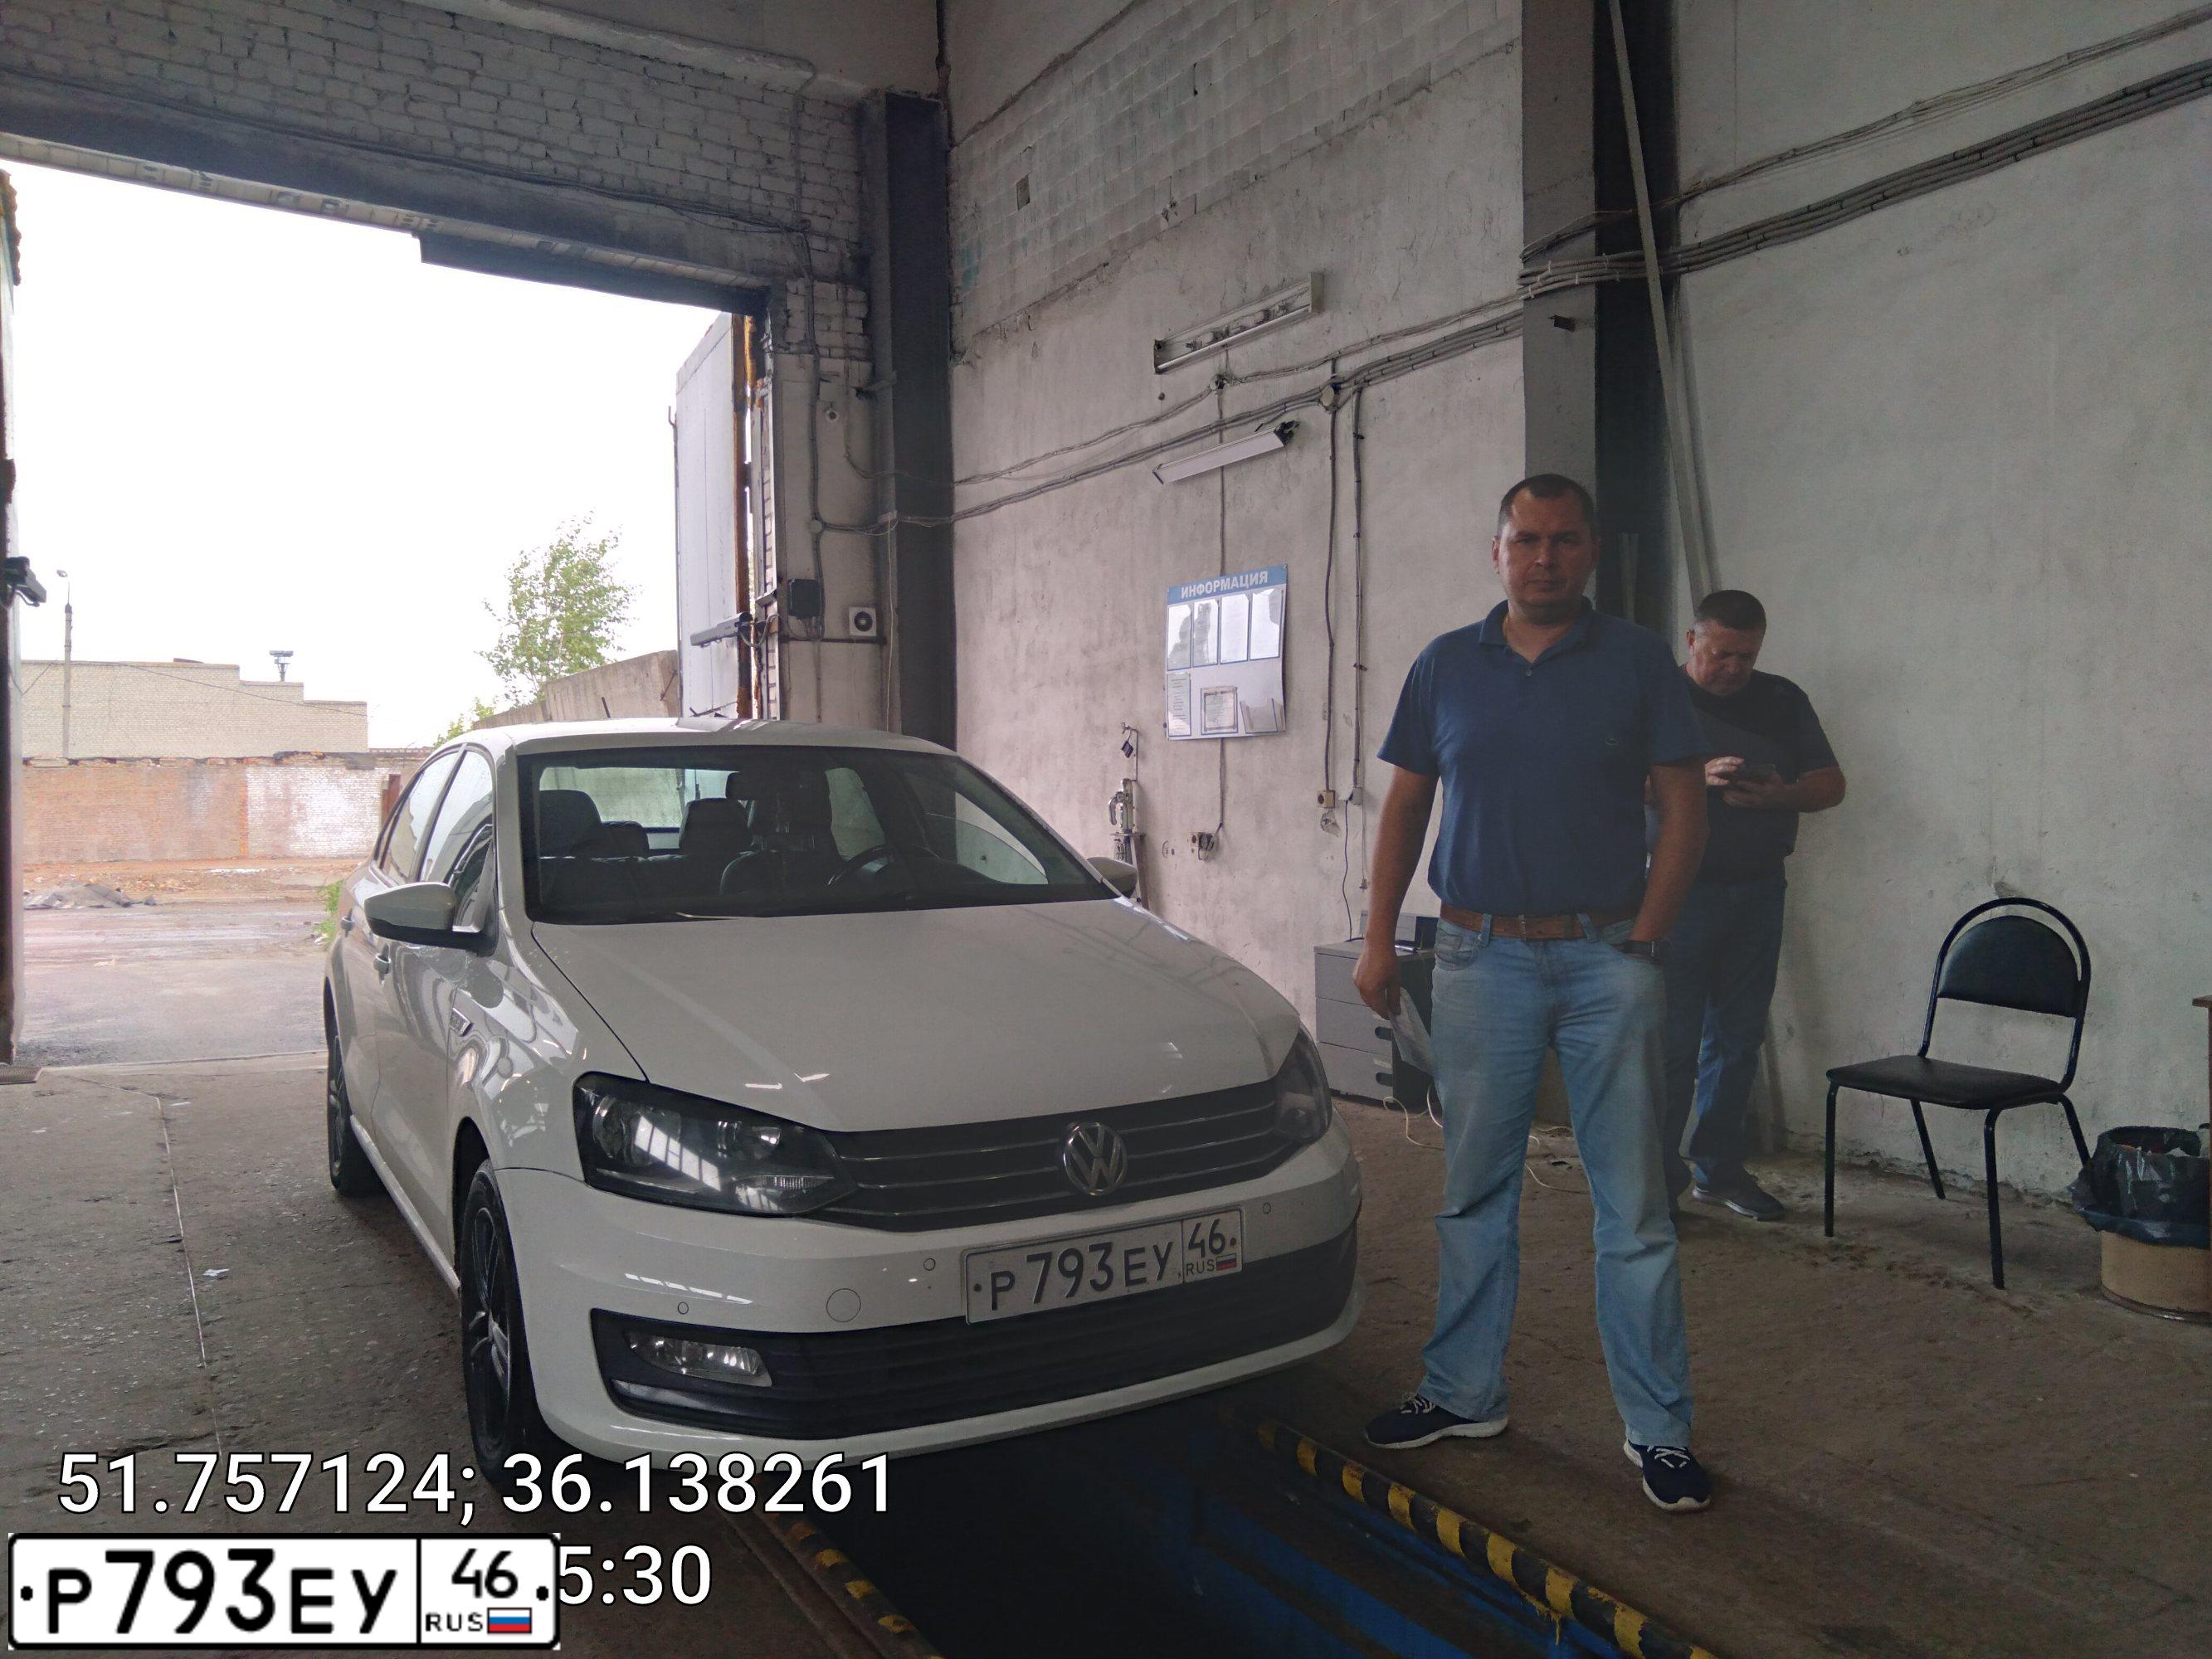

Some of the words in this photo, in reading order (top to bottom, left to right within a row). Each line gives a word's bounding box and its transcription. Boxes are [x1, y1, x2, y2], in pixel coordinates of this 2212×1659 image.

[1181, 570, 1269, 599] ИНФОРМАЦИЯ
[1187, 1219, 1226, 1259] 46
[1185, 1258, 1215, 1276] RUS
